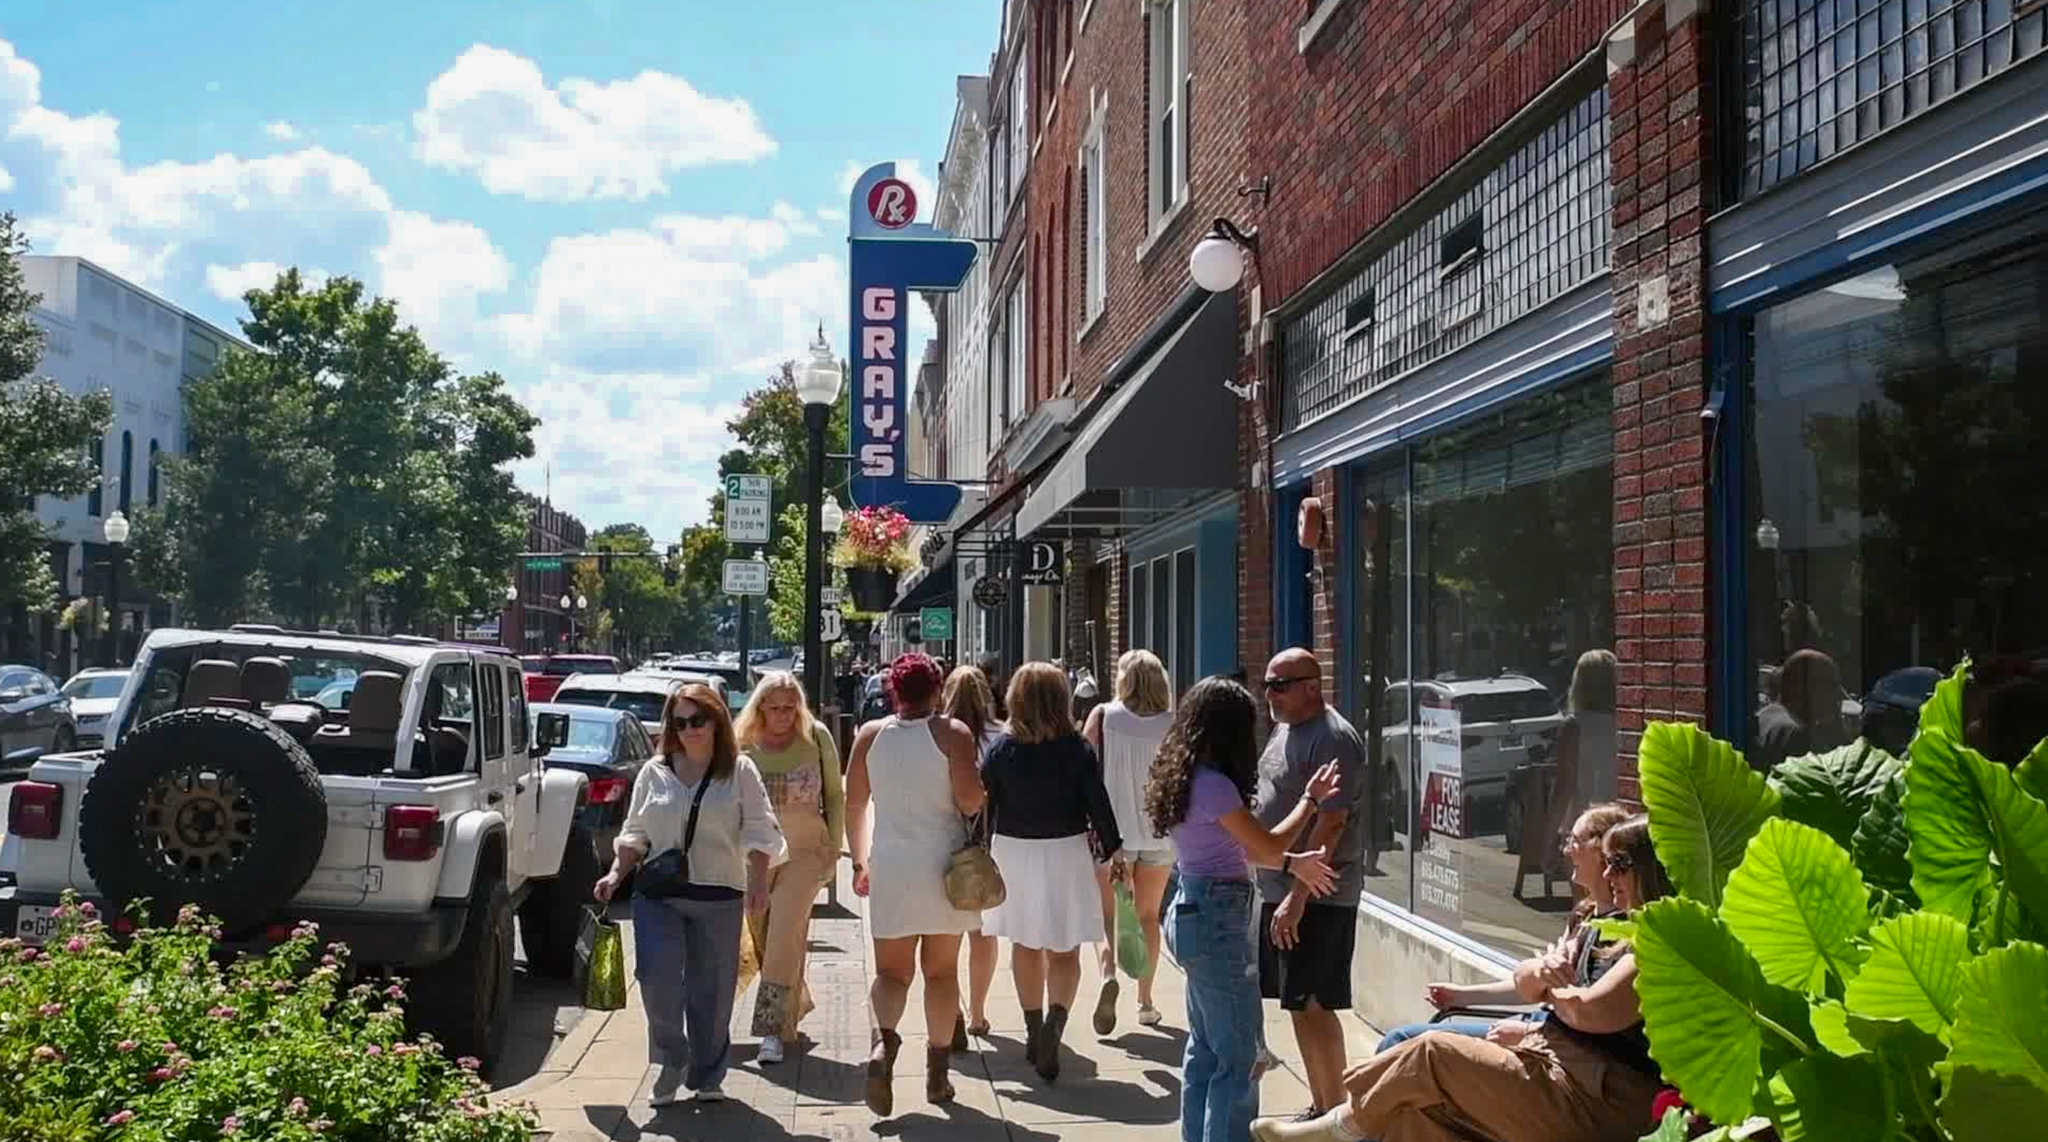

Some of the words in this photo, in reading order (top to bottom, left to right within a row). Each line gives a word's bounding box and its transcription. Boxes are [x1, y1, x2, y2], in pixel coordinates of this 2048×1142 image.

[861, 286, 900, 478] GRAY'S
[729, 479, 739, 497] 2
[752, 506, 761, 516] AM
[730, 520, 738, 529] TO
[755, 521, 765, 530] PM
[822, 590, 840, 600] UTH
[1441, 777, 1461, 807] FOR
[1430, 803, 1461, 837] LEASE
[35, 916, 56, 936] GP
